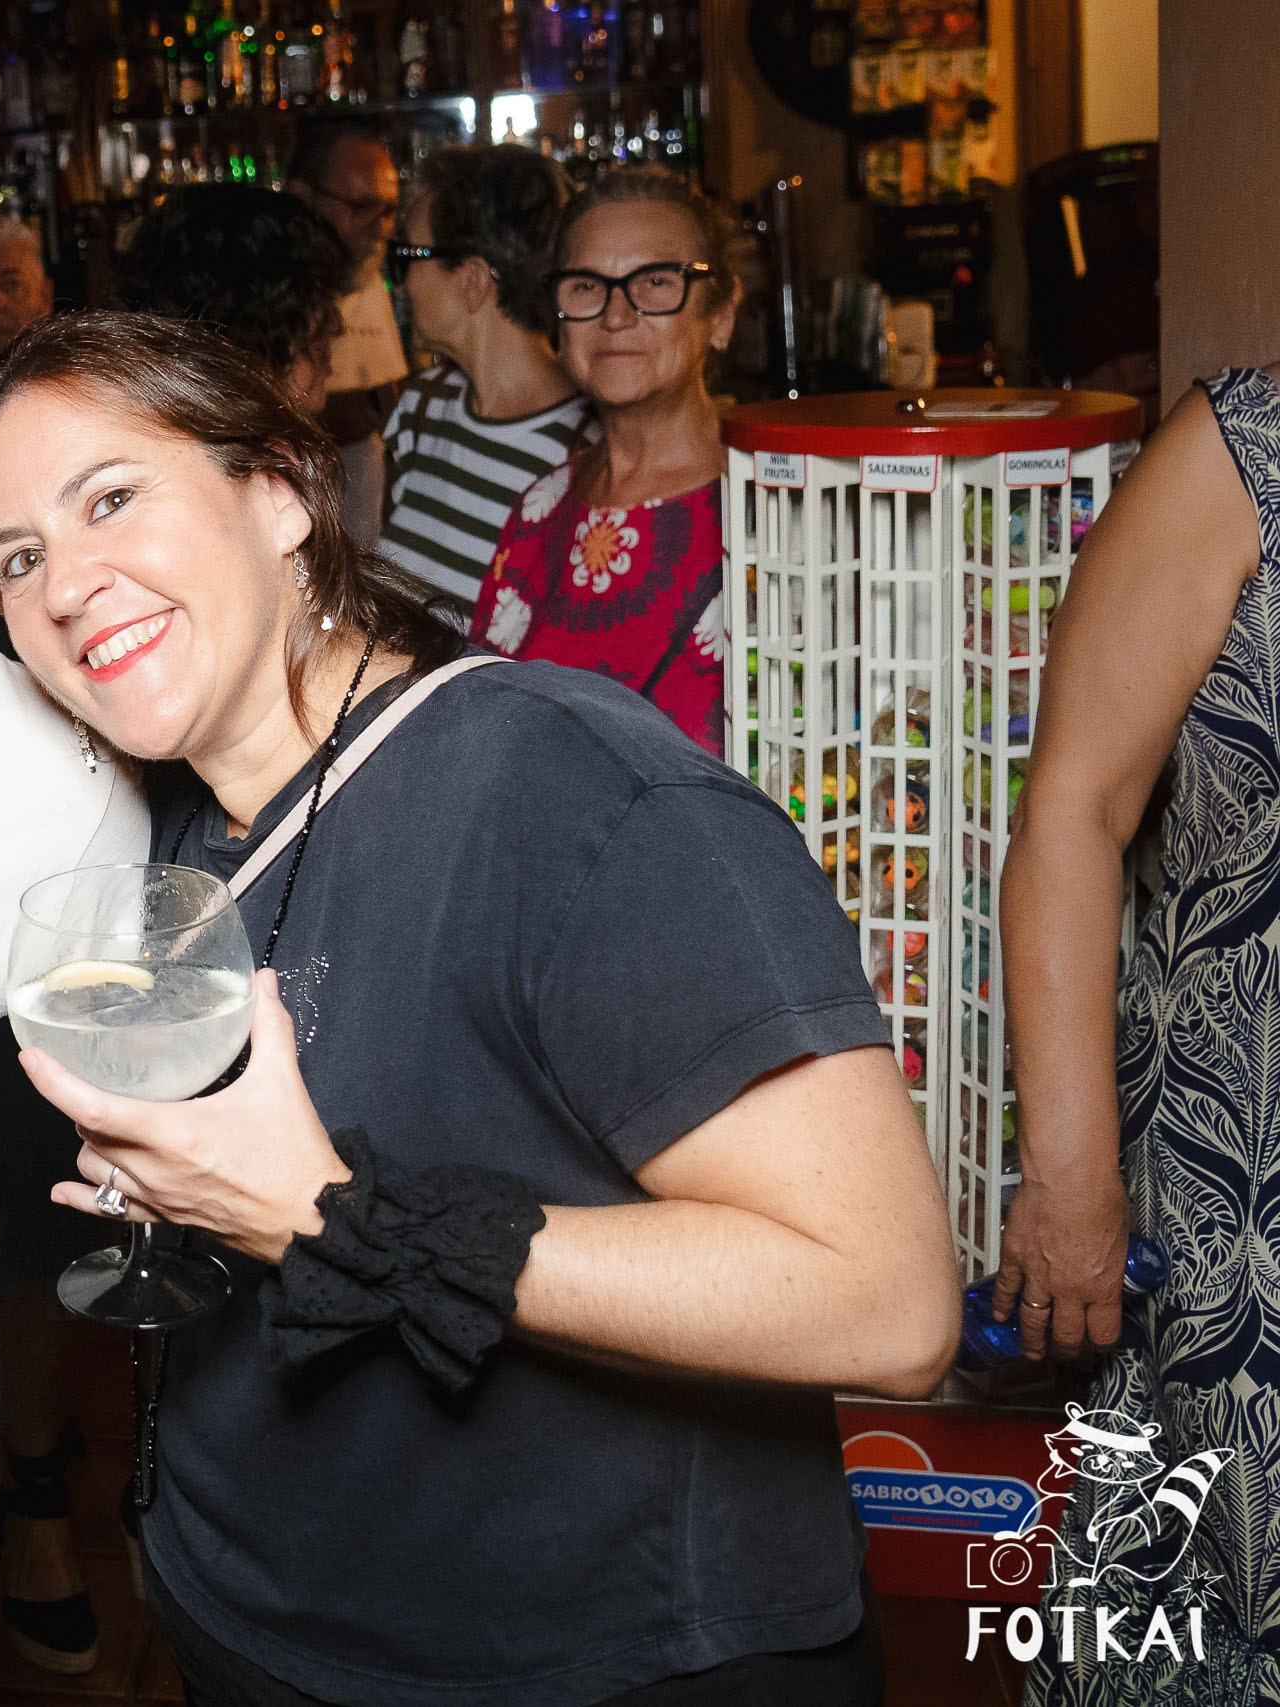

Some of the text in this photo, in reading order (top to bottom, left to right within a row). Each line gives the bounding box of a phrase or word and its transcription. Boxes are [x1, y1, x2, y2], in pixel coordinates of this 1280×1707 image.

[867, 463, 930, 477] SALTARINAS
[1008, 457, 1066, 471] GOMINOLAS
[764, 468, 796, 480] FRUTAS
[851, 1483, 1023, 1511] SABROTOYS
